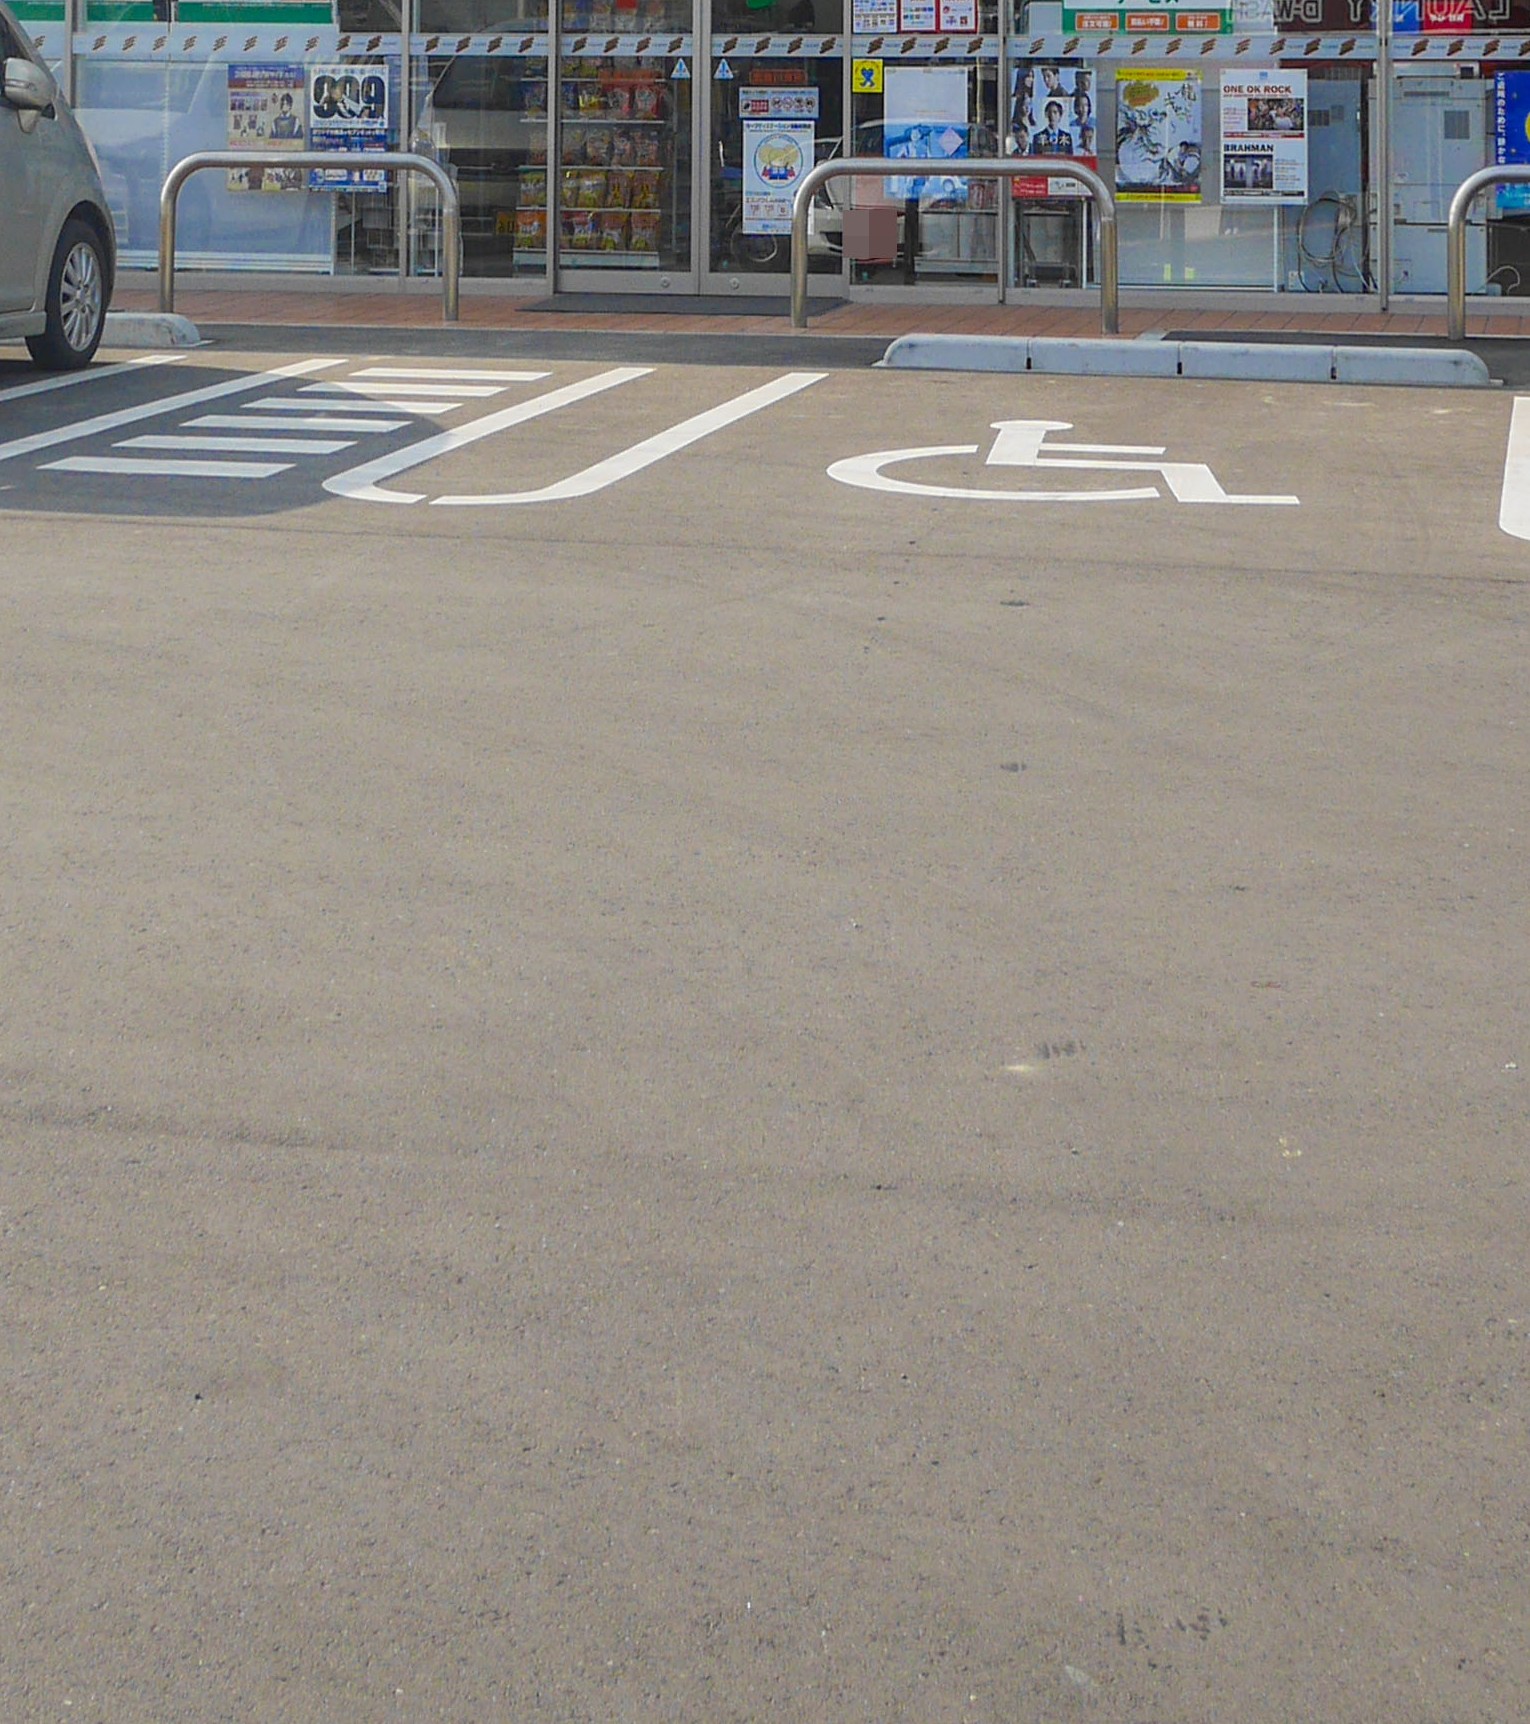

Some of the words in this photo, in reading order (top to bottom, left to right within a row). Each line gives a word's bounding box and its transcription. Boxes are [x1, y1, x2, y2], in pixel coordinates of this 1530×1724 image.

[1223, 85, 1243, 94] ONE
[1246, 85, 1261, 94] OK
[1263, 85, 1292, 94] ROCK
[1223, 143, 1274, 153] BRAHMAN
